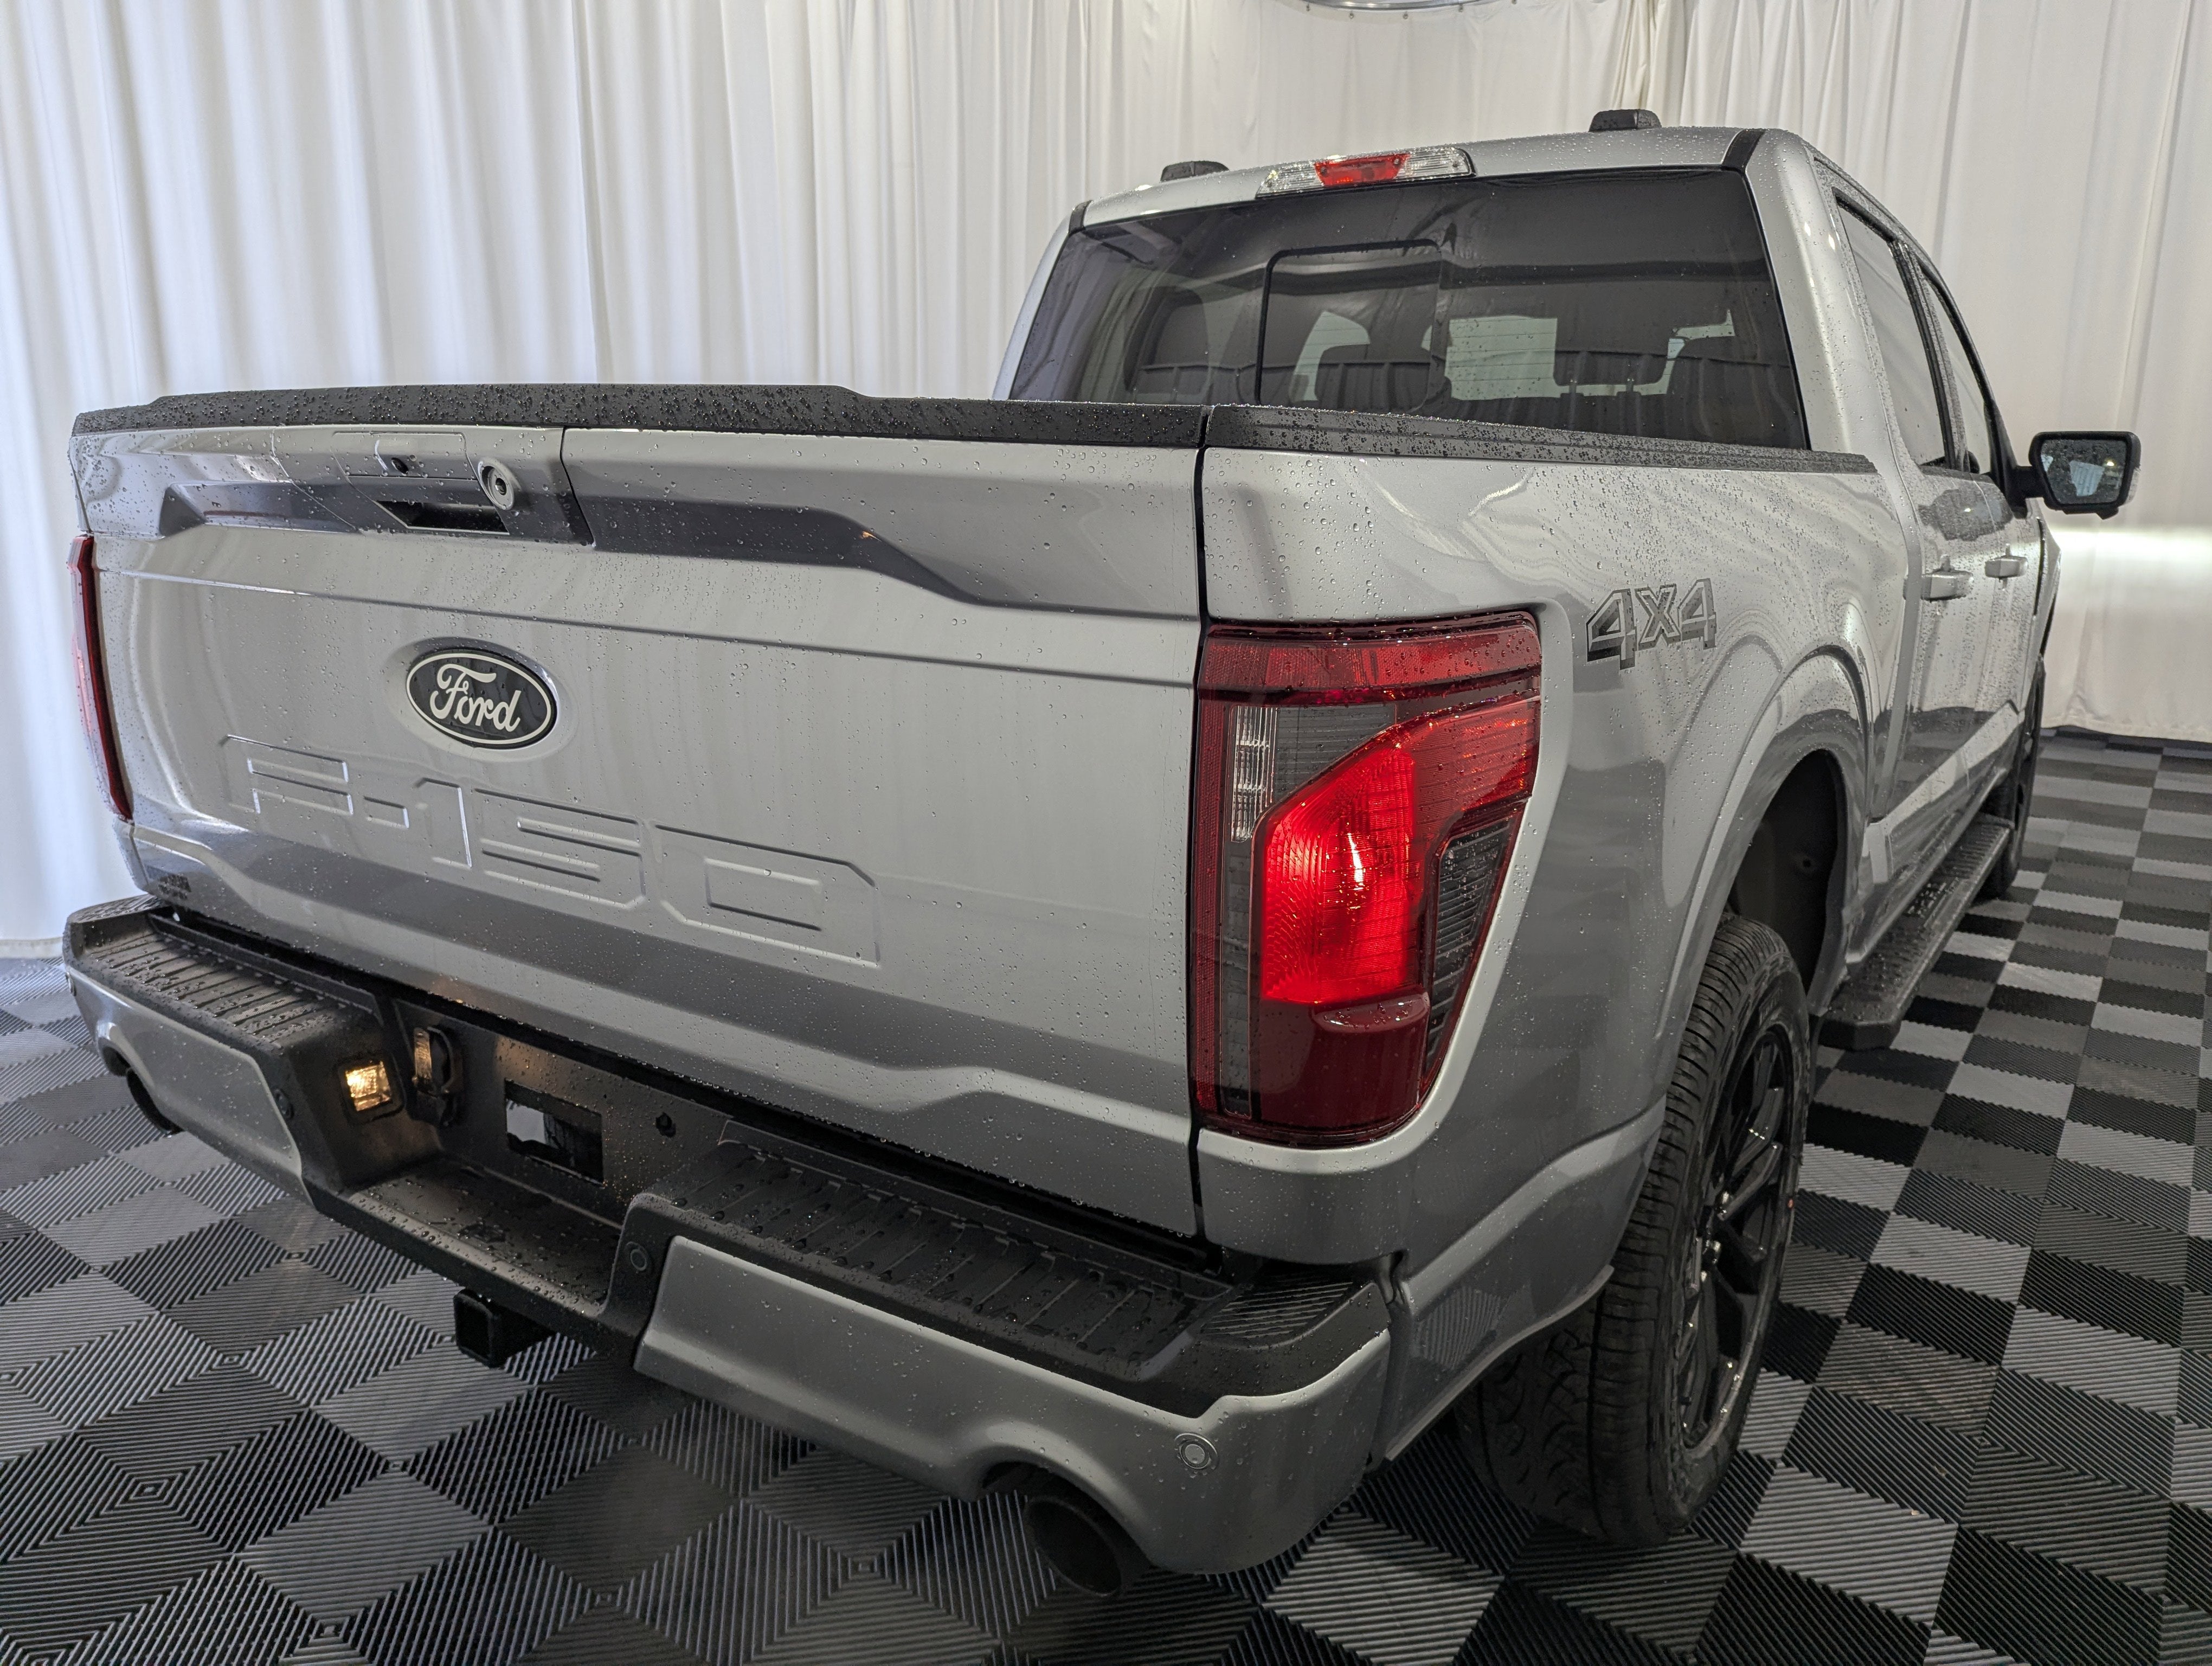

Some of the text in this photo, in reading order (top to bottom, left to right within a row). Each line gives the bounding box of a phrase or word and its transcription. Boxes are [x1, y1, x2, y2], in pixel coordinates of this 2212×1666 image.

[1586, 578, 1717, 670] 4X4
[430, 663, 521, 732] Ford
[218, 734, 882, 968] F-150
